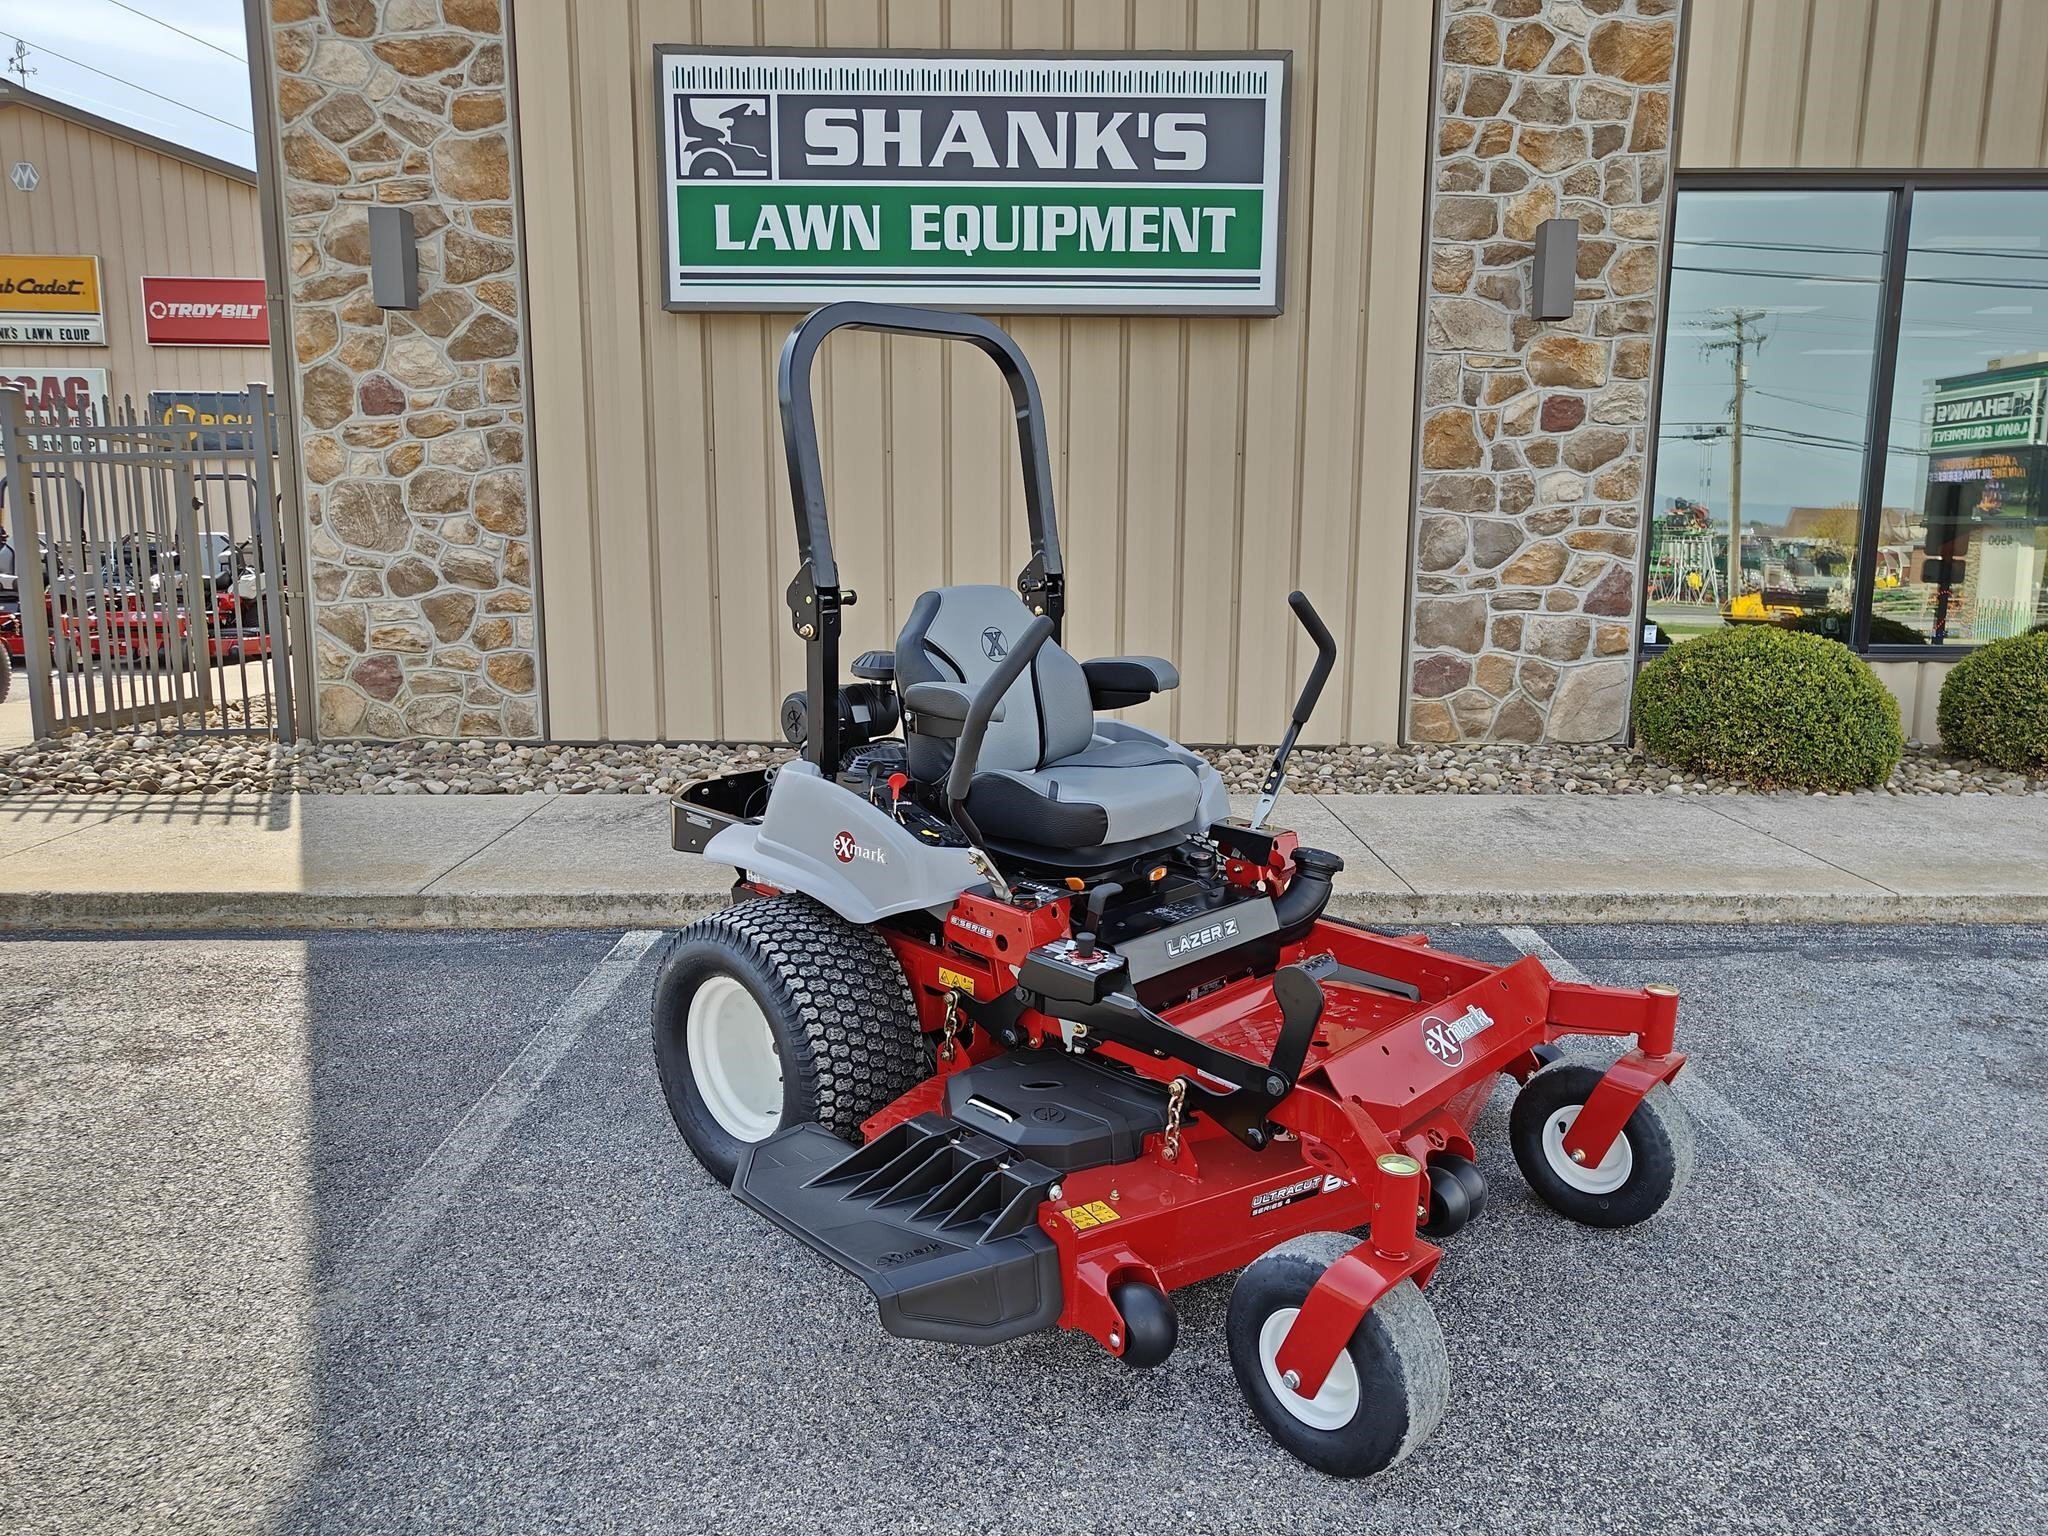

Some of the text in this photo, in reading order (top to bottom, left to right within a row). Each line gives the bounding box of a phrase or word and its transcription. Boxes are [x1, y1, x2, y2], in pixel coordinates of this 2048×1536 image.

[803, 108, 1208, 171] SHANK'S
[714, 204, 1237, 256] LAWN EQUIPMENT
[16, 278, 84, 295] Cadet
[167, 303, 262, 319] TROY-BILT
[24, 327, 53, 341] LAWN
[1167, 918, 1239, 957] LAZER Z
[1252, 1175, 1323, 1207] ULTRACUT
[1252, 1198, 1292, 1216] SERIES 4
